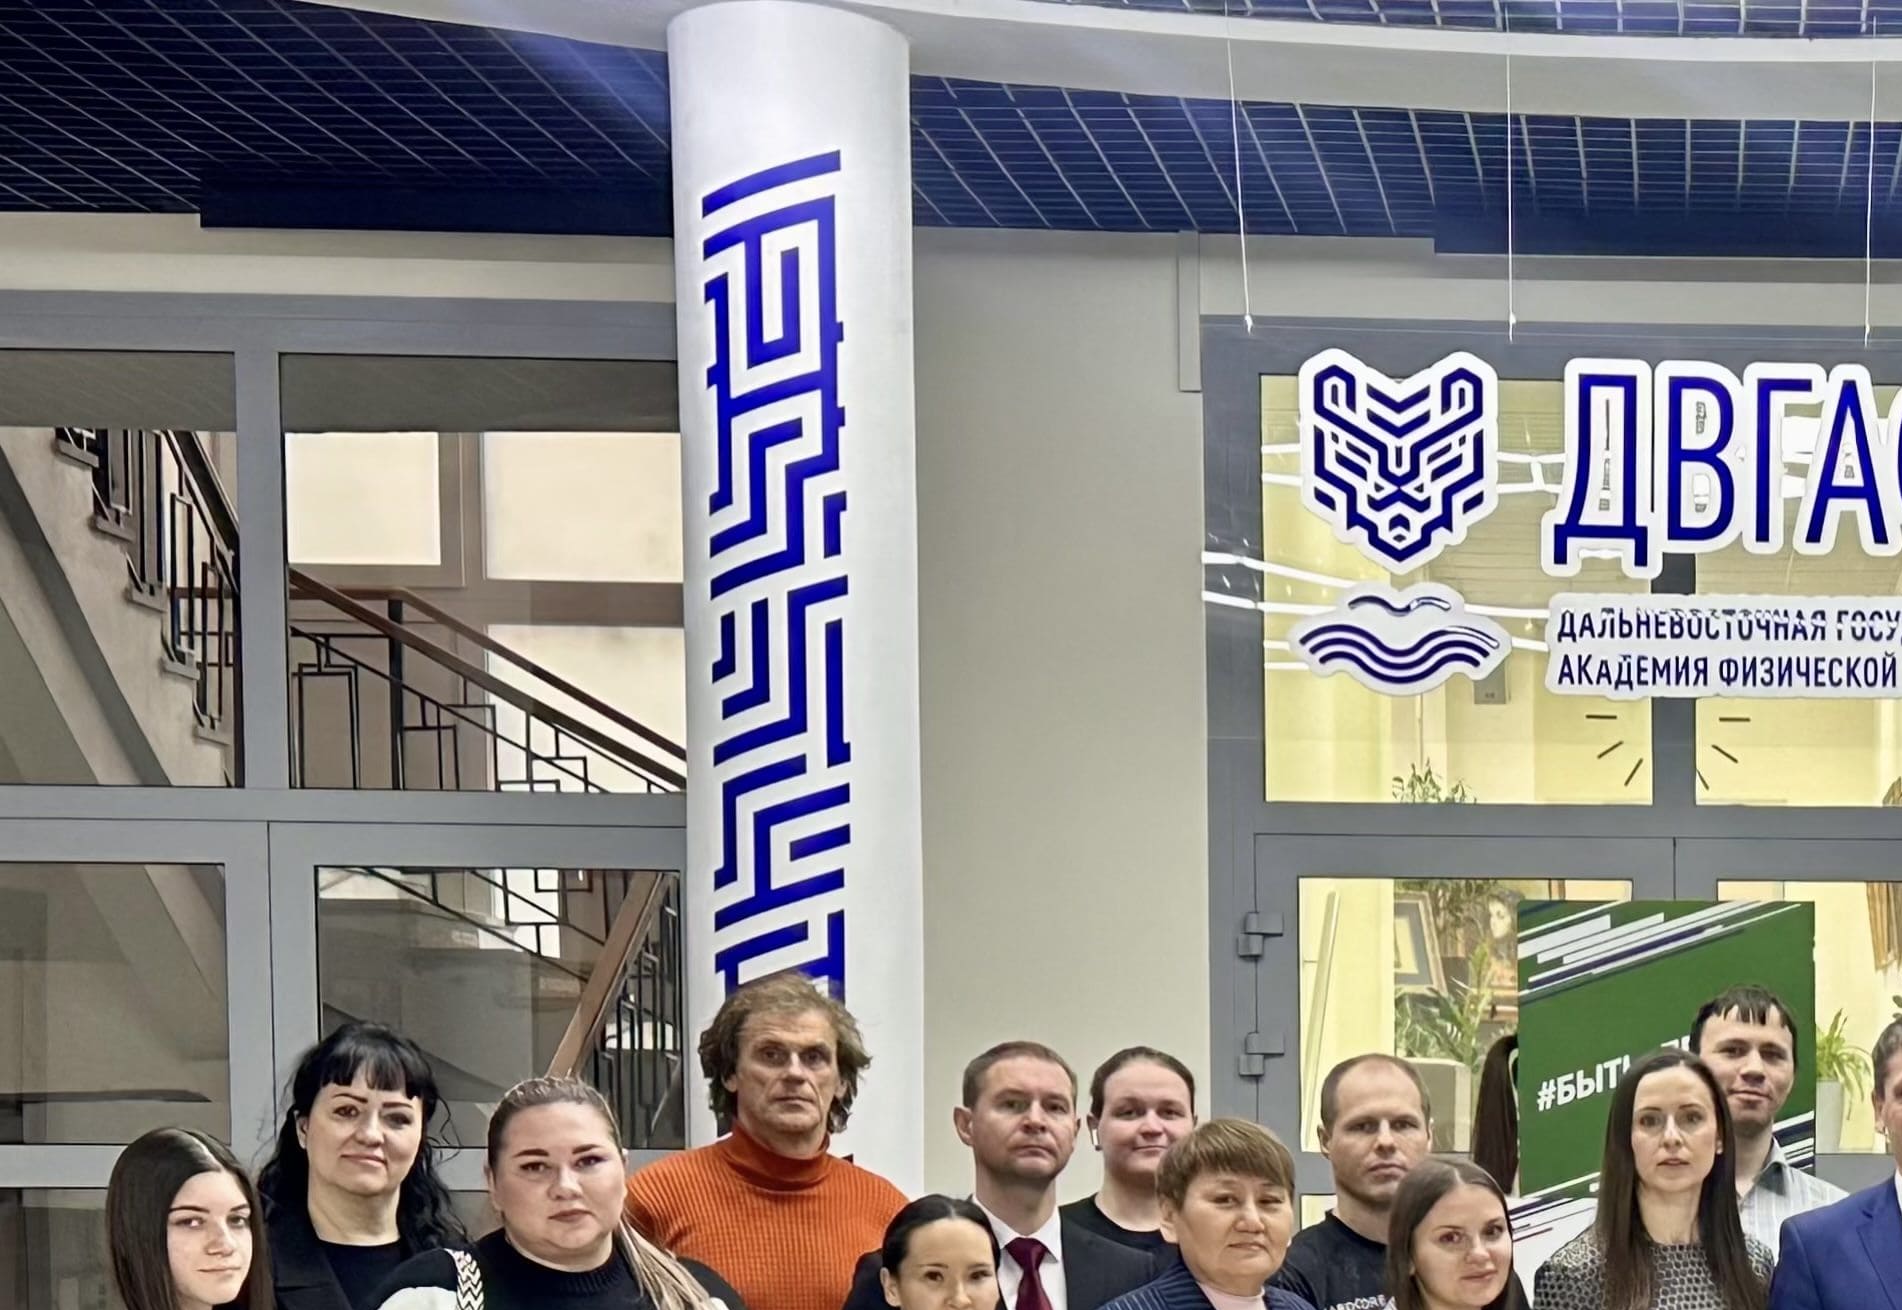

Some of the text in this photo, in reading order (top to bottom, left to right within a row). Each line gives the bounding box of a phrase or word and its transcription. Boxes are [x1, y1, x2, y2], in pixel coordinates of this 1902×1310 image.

[1556, 607, 1826, 643] ДАЛЬНЕВОСТОЧНАЯ
[1557, 653, 1708, 691] АКАДЕМИЯ
[1718, 651, 1897, 688] ФИЗИЧЕСКОЙ
